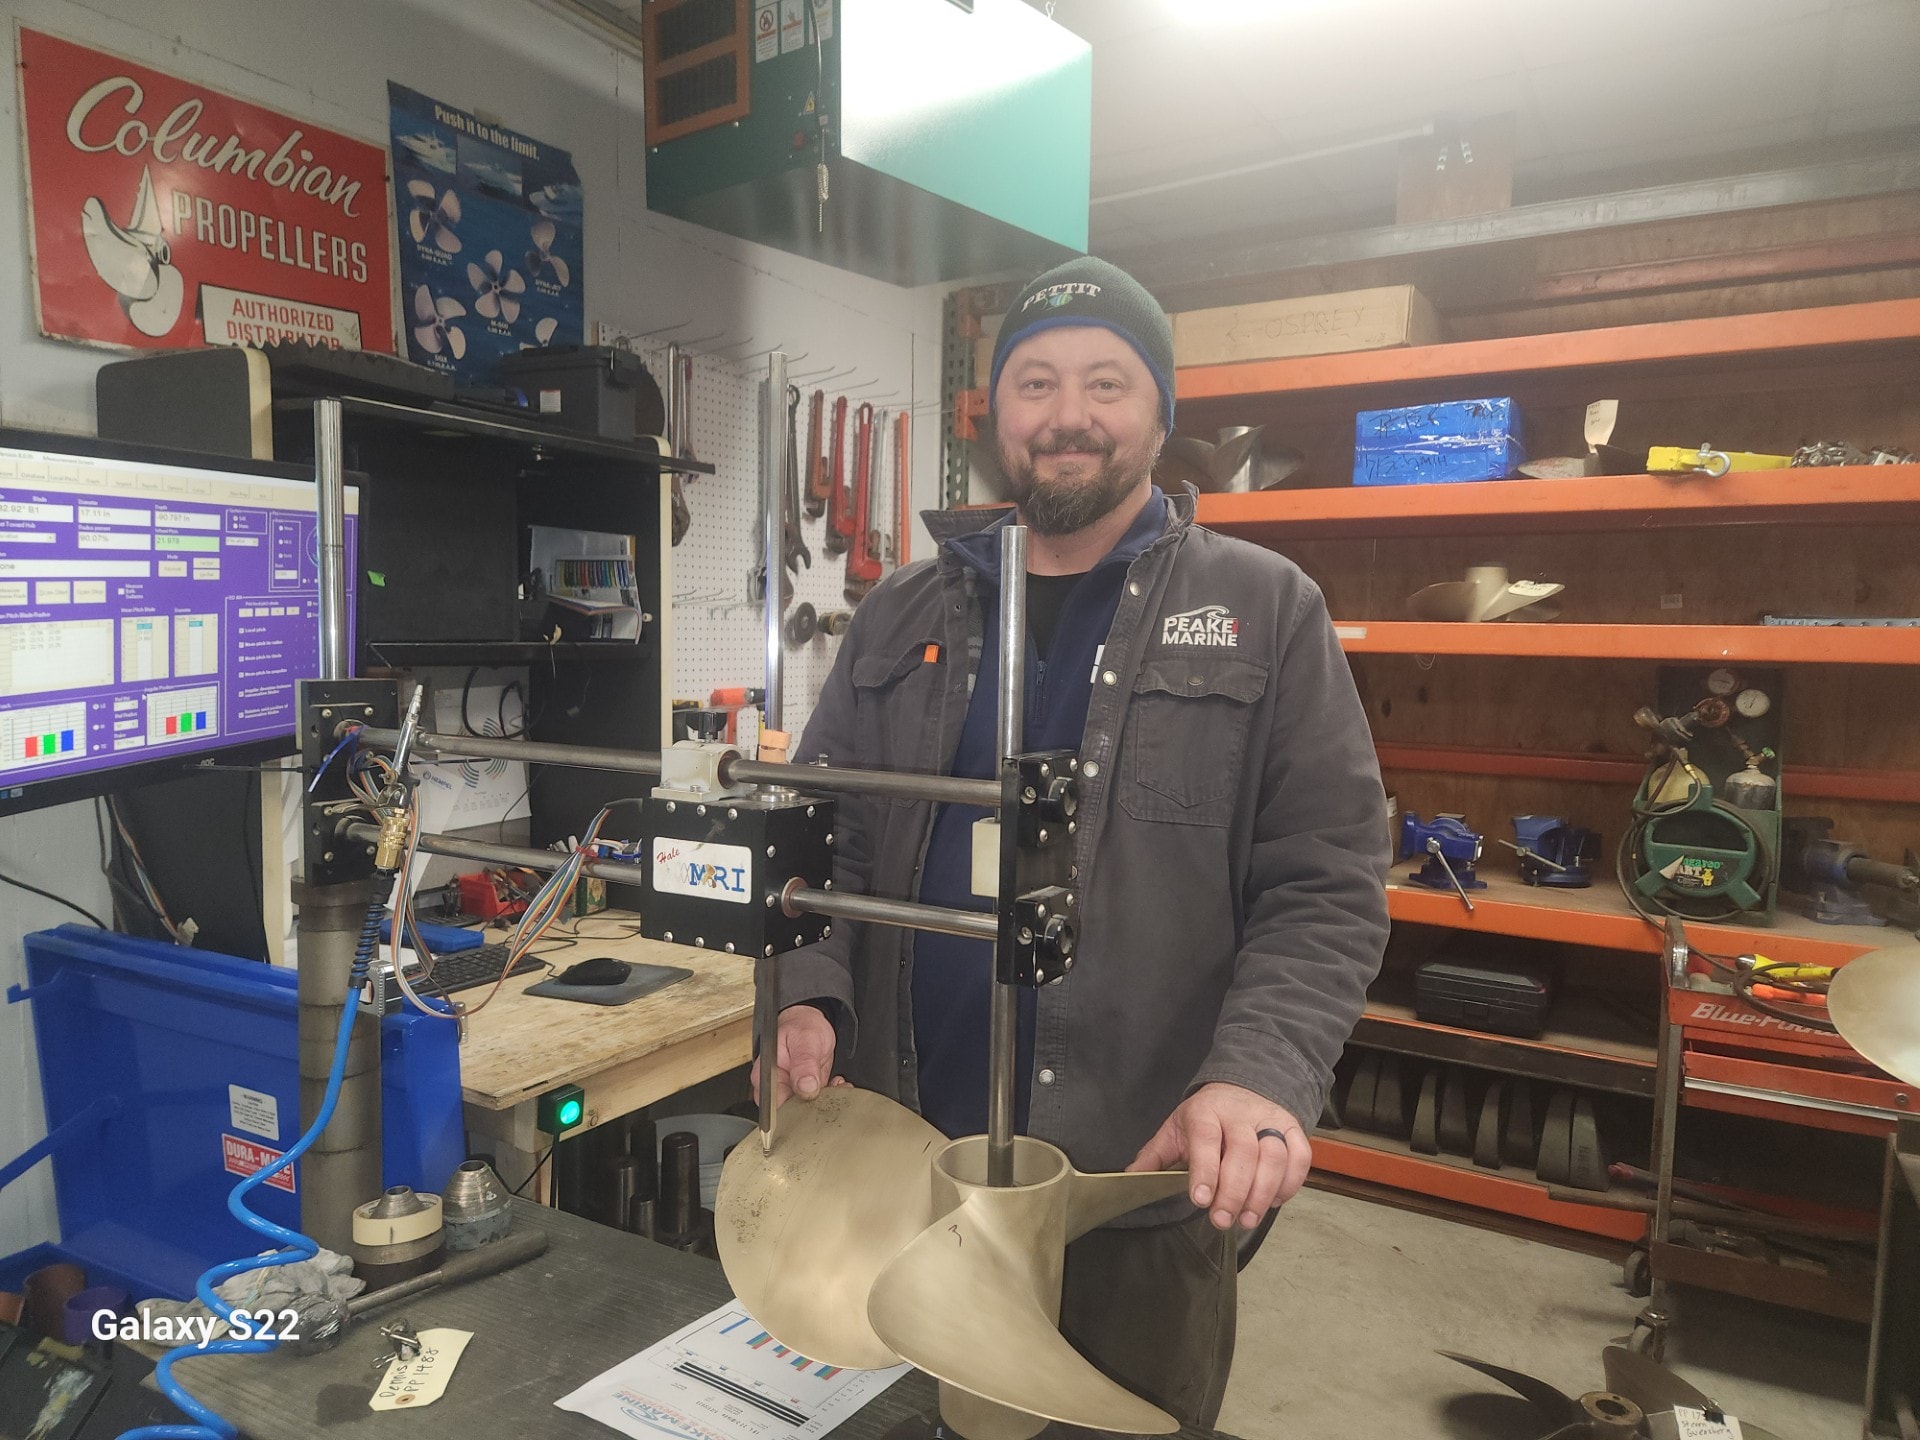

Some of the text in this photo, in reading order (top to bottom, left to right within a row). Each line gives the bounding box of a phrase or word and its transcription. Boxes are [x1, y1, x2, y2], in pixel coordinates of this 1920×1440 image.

[66, 75, 361, 218] Columbian
[434, 104, 541, 161] Push it to the limit.
[173, 190, 368, 283] PROPELLERS
[1021, 283, 1102, 312] PETTIT
[232, 298, 335, 332] AUTHORIZED
[1161, 631, 1238, 647] MARINE
[1164, 616, 1234, 634] PEAKE
[656, 847, 681, 865] Hale
